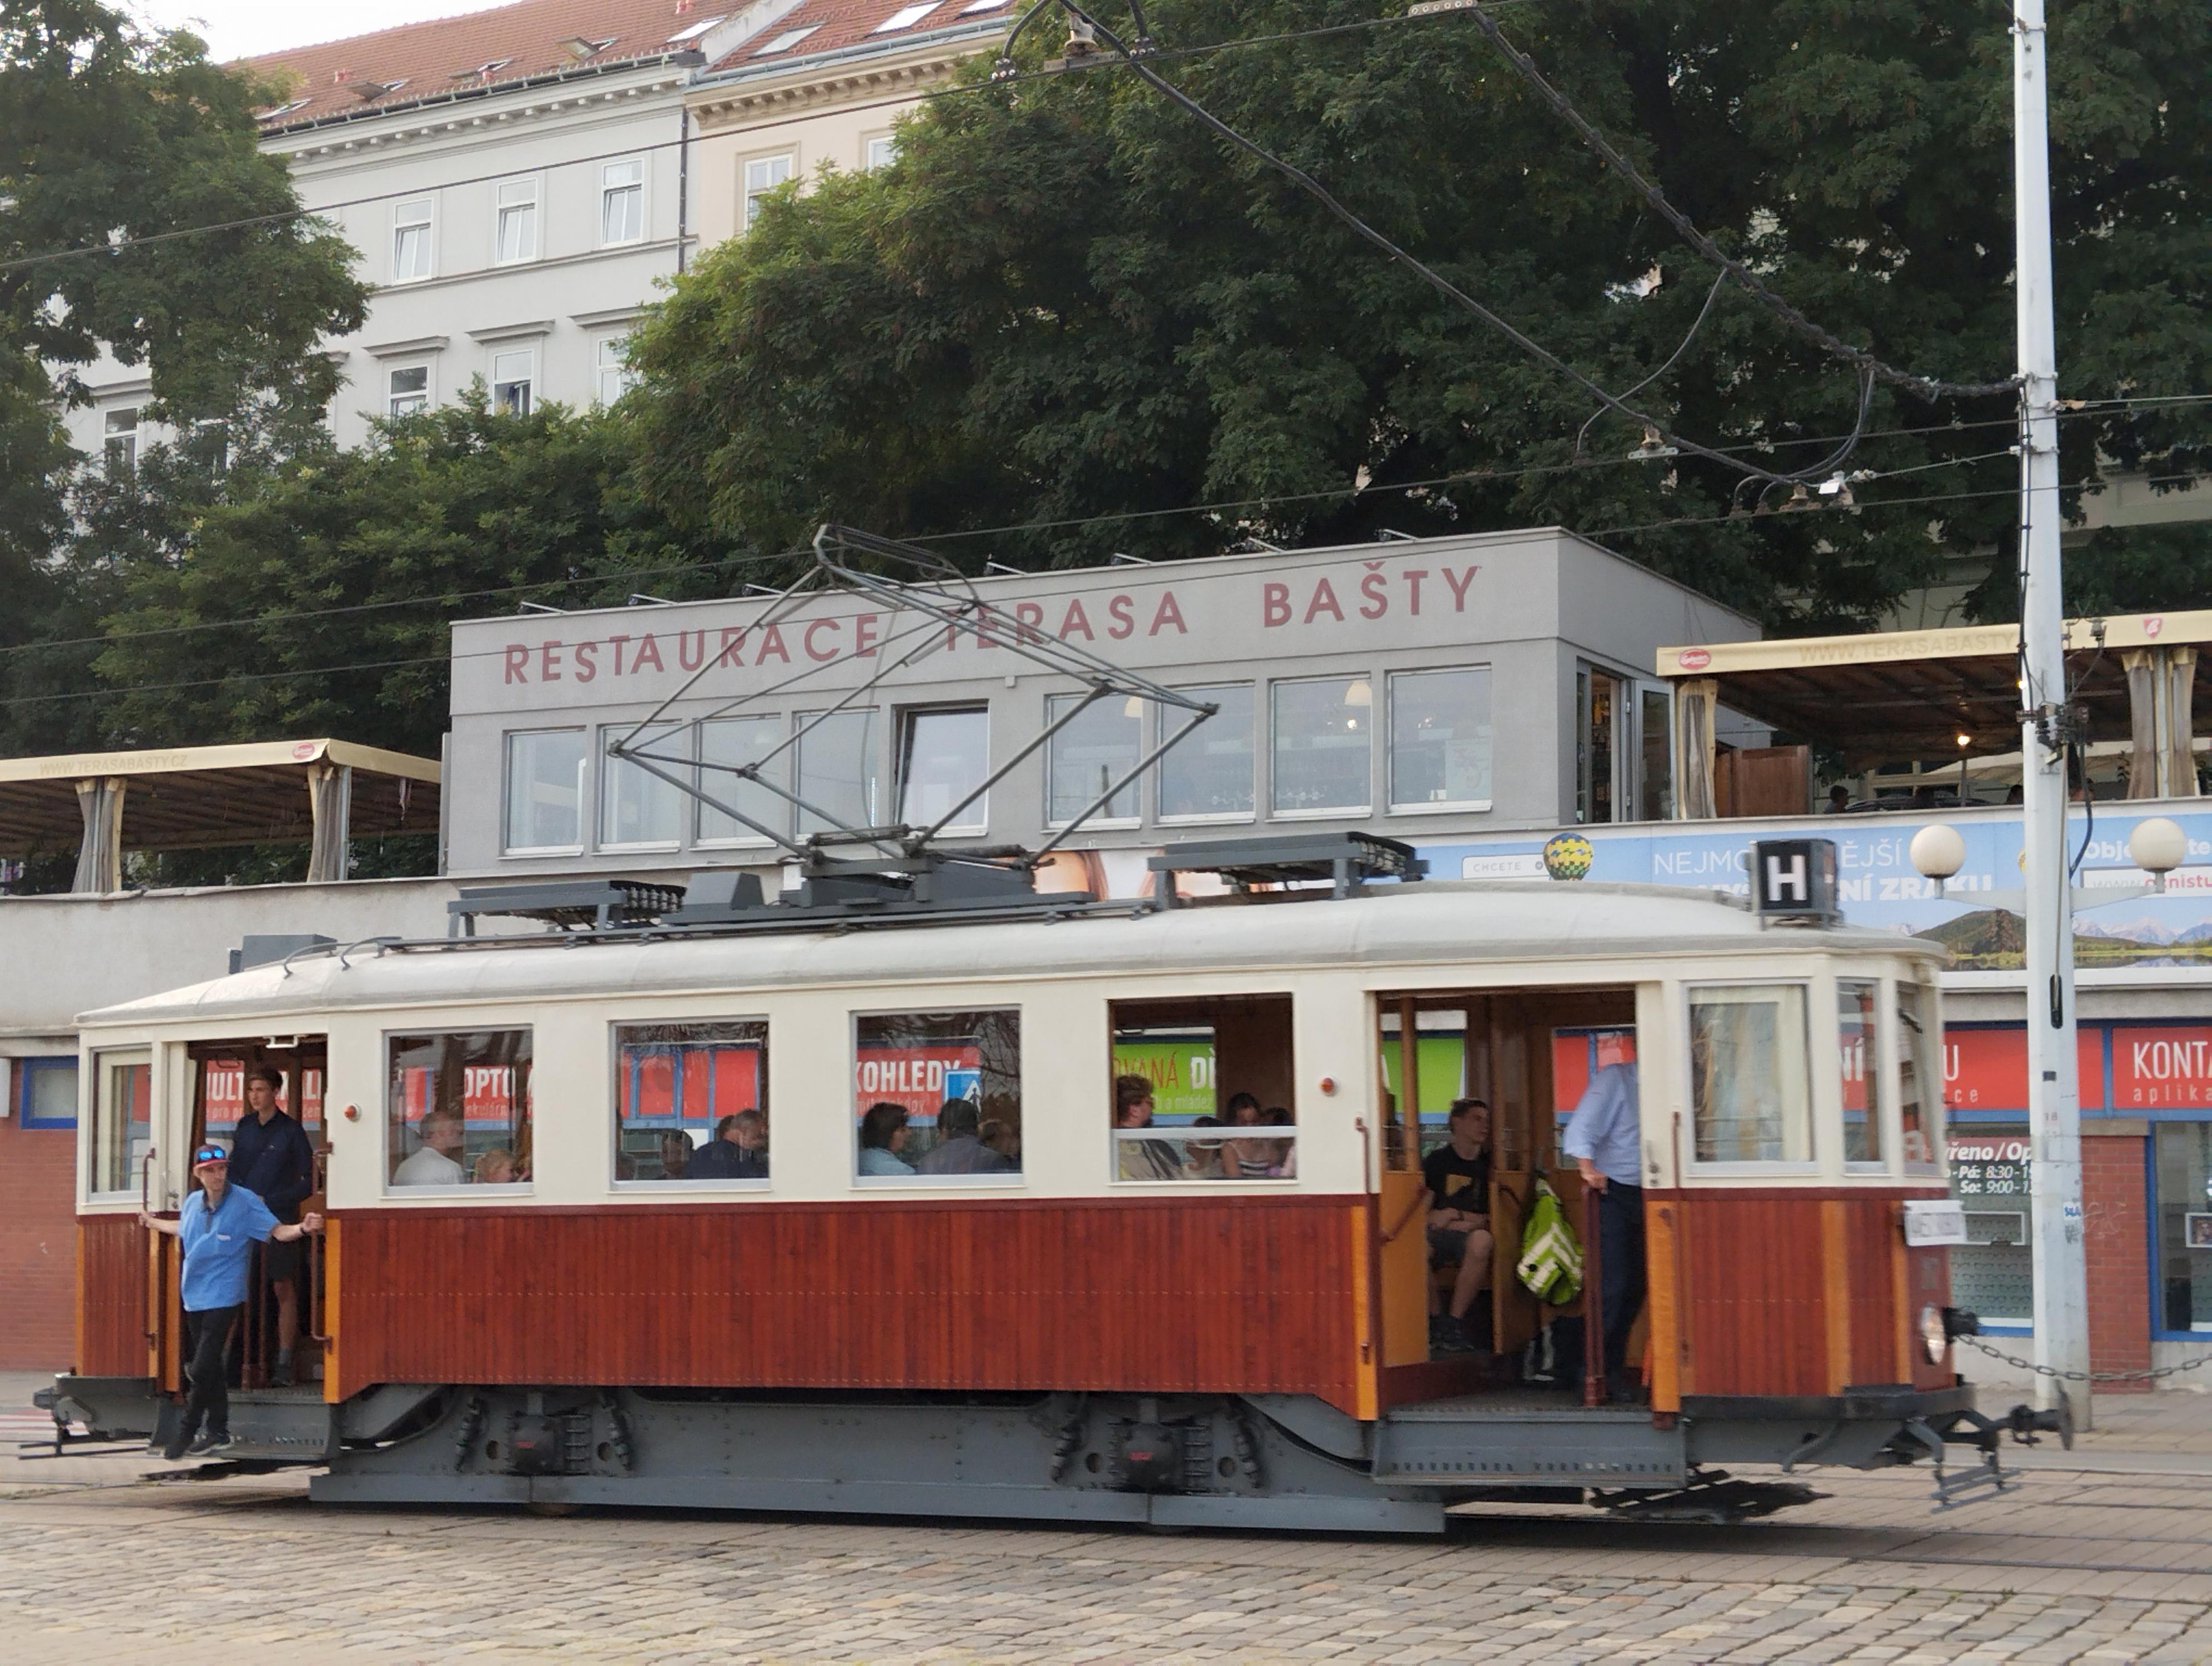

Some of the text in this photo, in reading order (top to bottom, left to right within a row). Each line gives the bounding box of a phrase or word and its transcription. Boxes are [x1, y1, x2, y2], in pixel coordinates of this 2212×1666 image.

[504, 560, 1481, 685] RESTAURACE TERASA BAŠTY
[1472, 861, 1522, 872] CHCETE
[1766, 855, 1807, 901] H
[2133, 1041, 2212, 1080] KONT
